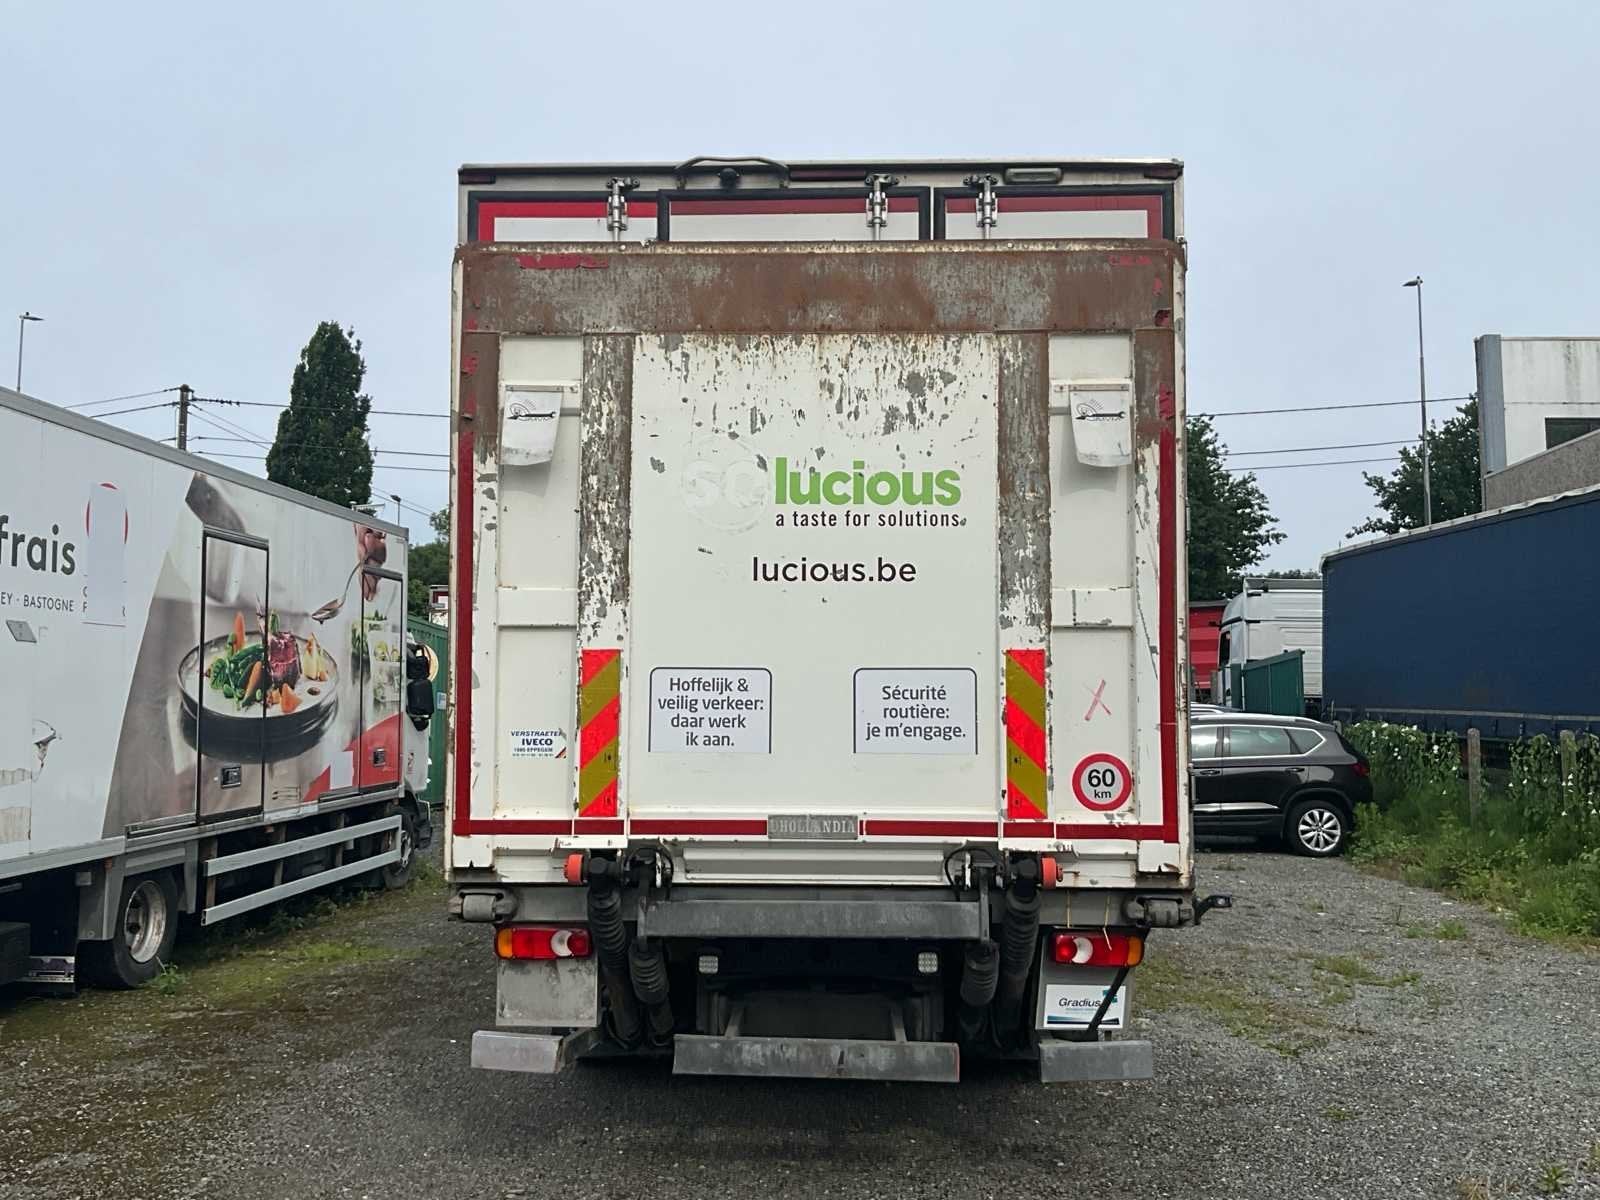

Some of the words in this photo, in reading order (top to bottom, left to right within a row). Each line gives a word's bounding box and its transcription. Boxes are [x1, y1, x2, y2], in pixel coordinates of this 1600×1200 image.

[775, 457, 961, 506] lucious
[775, 513, 785, 527] a
[793, 511, 838, 527] taste
[845, 510, 871, 527] for
[752, 557, 917, 582] lucious.be
[23, 594, 75, 613] BASTOGNE
[669, 677, 734, 695] Hoffelijk
[737, 678, 749, 692] &
[881, 684, 947, 700] Sécurité
[658, 695, 699, 713] veilig
[702, 696, 764, 710] verkeer:
[883, 703, 950, 719] routière:
[671, 713, 705, 728] daar
[708, 714, 747, 728] werk
[686, 731, 699, 746] ik
[702, 735, 735, 747] aan.
[865, 722, 881, 741] je
[521, 738, 553, 746] IVECO
[1087, 768, 1116, 788] 60
[1093, 789, 1112, 799] km
[1058, 997, 1101, 1008] Gradius
